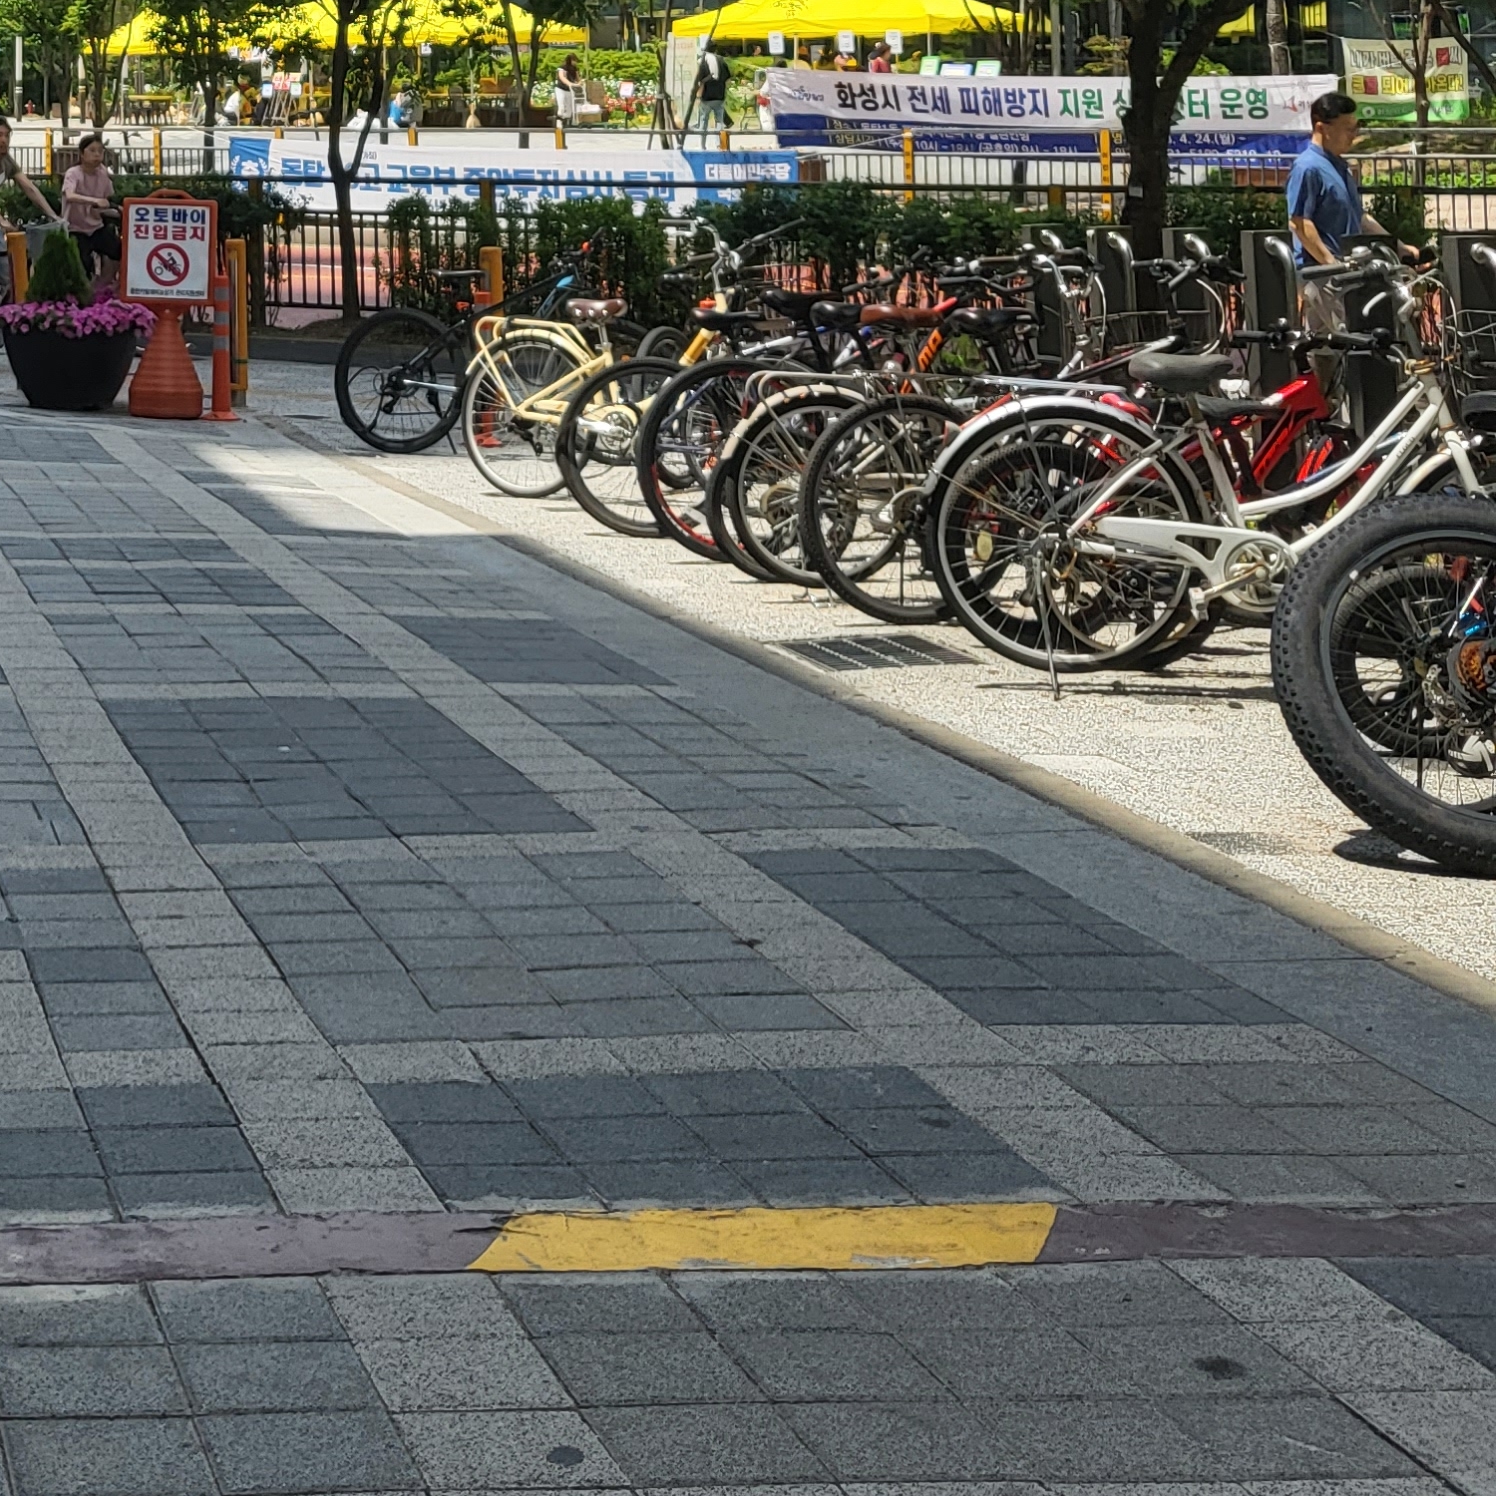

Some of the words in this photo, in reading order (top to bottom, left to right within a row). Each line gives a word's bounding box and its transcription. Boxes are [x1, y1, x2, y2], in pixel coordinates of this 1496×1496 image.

[834, 81, 901, 112] 화성시
[905, 85, 952, 115] 전세
[957, 86, 1050, 118] 피해방지
[1057, 88, 1104, 120] 지원
[1219, 88, 1270, 120] 운영
[280, 157, 326, 188] 동탄
[463, 166, 614, 201] 중앙투자심사
[622, 169, 676, 203] 통과
[704, 163, 791, 181] 더불어민주당
[134, 206, 206, 225] 오토바이
[133, 223, 206, 242] 진입금지
